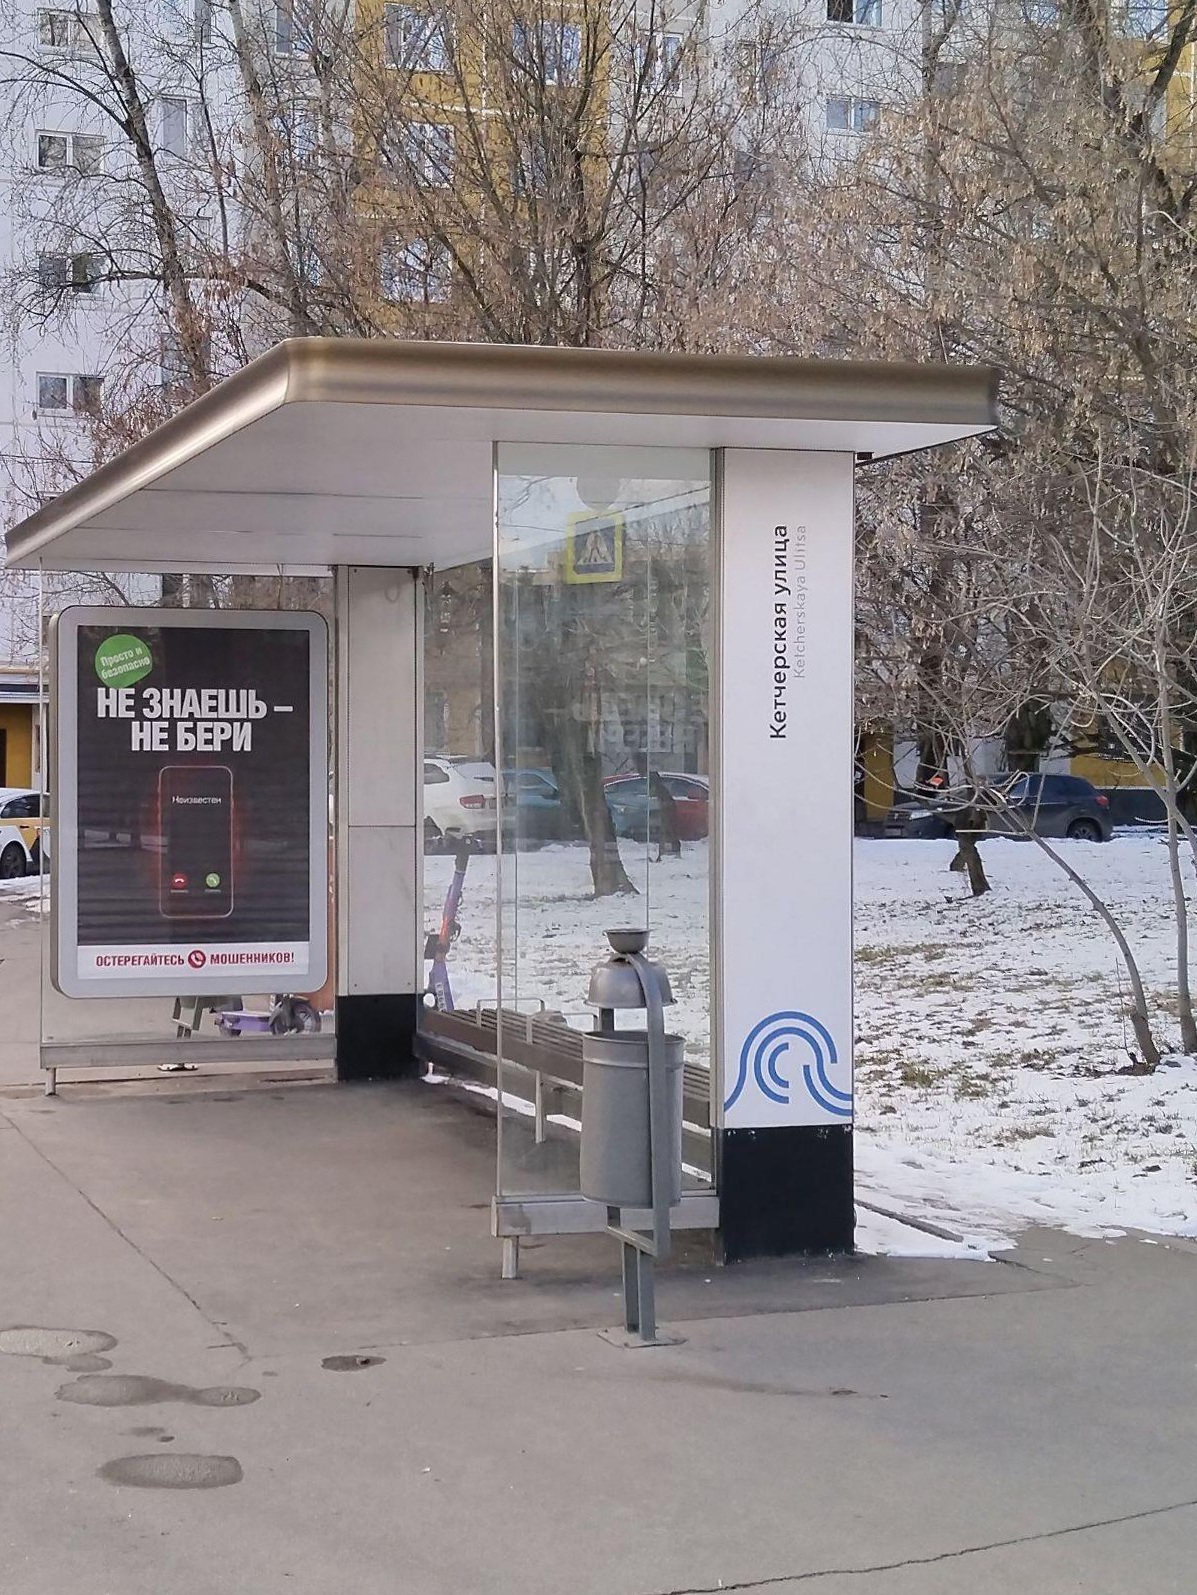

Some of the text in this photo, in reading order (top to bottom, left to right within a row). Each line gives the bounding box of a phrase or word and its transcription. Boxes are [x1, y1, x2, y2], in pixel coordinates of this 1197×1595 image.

[793, 524, 809, 679] Ketcherskaya Ulitsa
[769, 524, 791, 739] Кетчерская улица
[100, 647, 143, 668] Просто и
[101, 656, 151, 680] безопасно
[97, 687, 136, 718] НЕ
[142, 687, 267, 719] ЗНАЕШЬ
[131, 721, 252, 752] НЕ БЕРИ
[172, 796, 222, 804] Неизвестен
[96, 952, 295, 967] ОСТЕРЕГАЙТЕСЬ МОШЕННИКОВ!
